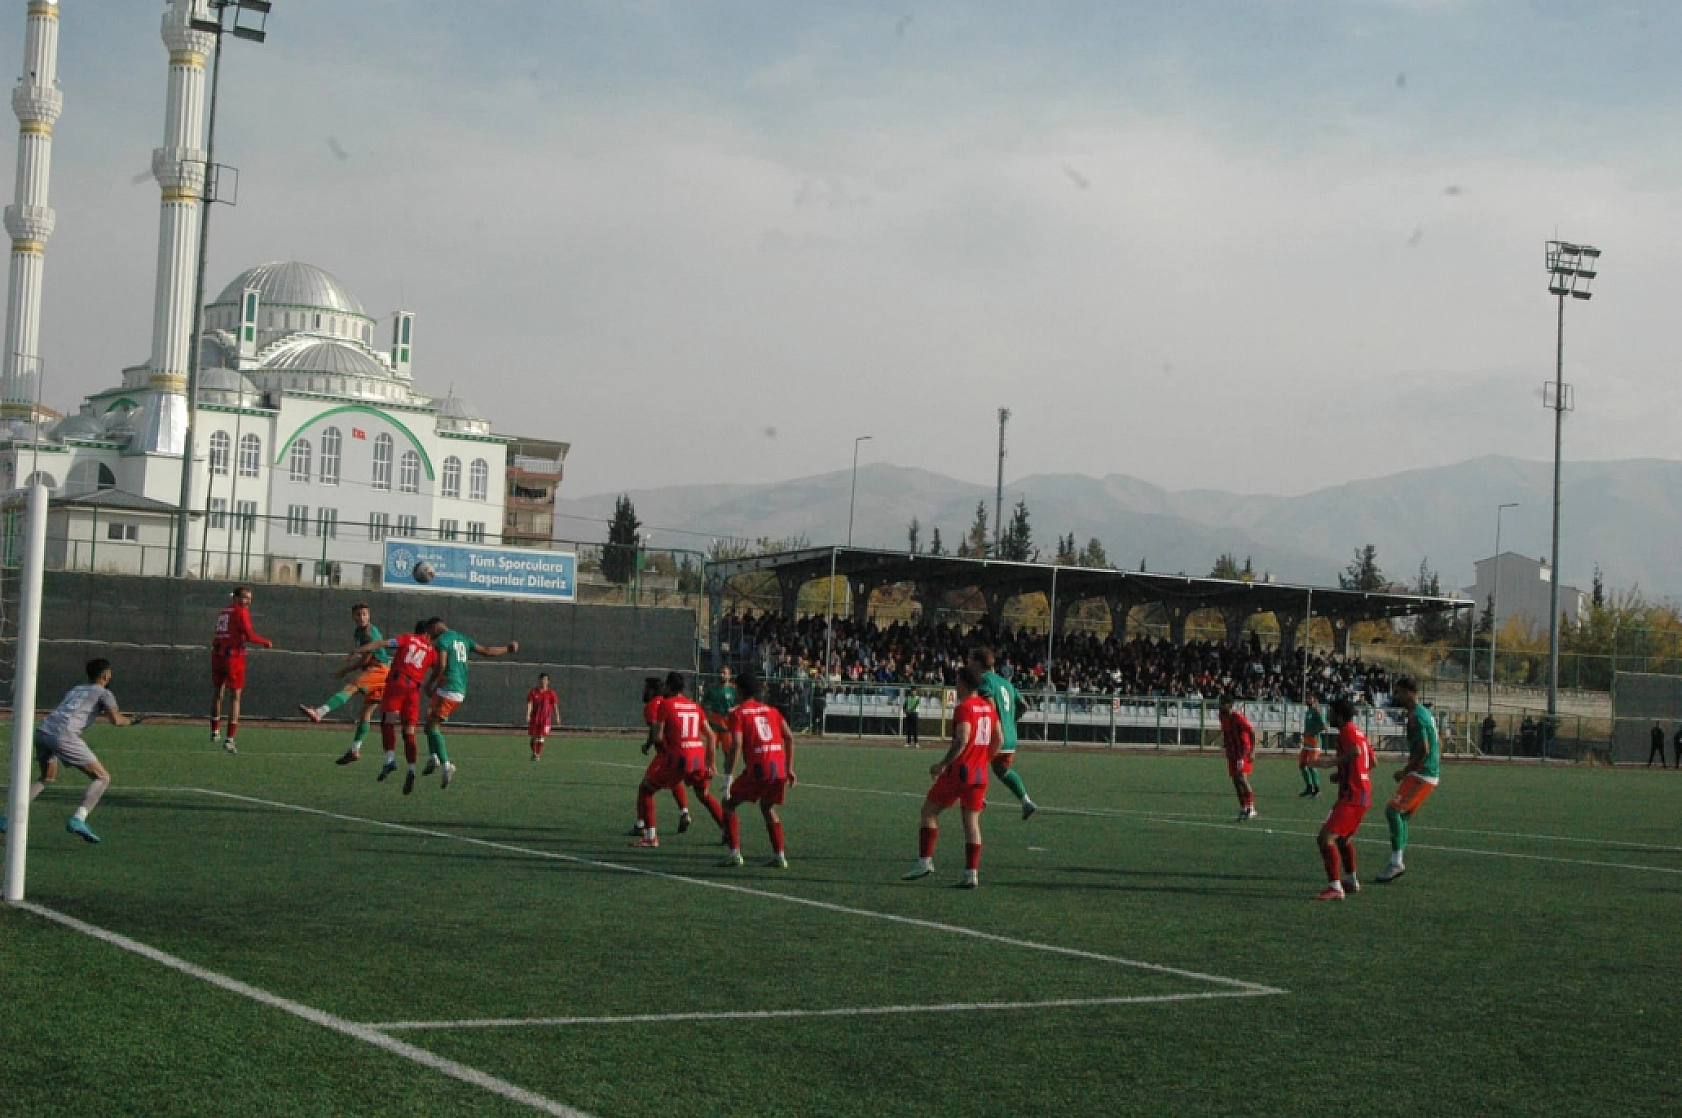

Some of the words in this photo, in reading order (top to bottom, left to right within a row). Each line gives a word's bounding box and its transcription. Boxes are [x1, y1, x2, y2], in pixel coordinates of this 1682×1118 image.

[469, 554, 494, 567] Tüm
[499, 556, 563, 573] Sporculara
[527, 574, 567, 589] Dileriz
[404, 643, 427, 669] 14
[453, 639, 467, 663] 19
[677, 711, 700, 738] 77
[754, 716, 774, 741] 6
